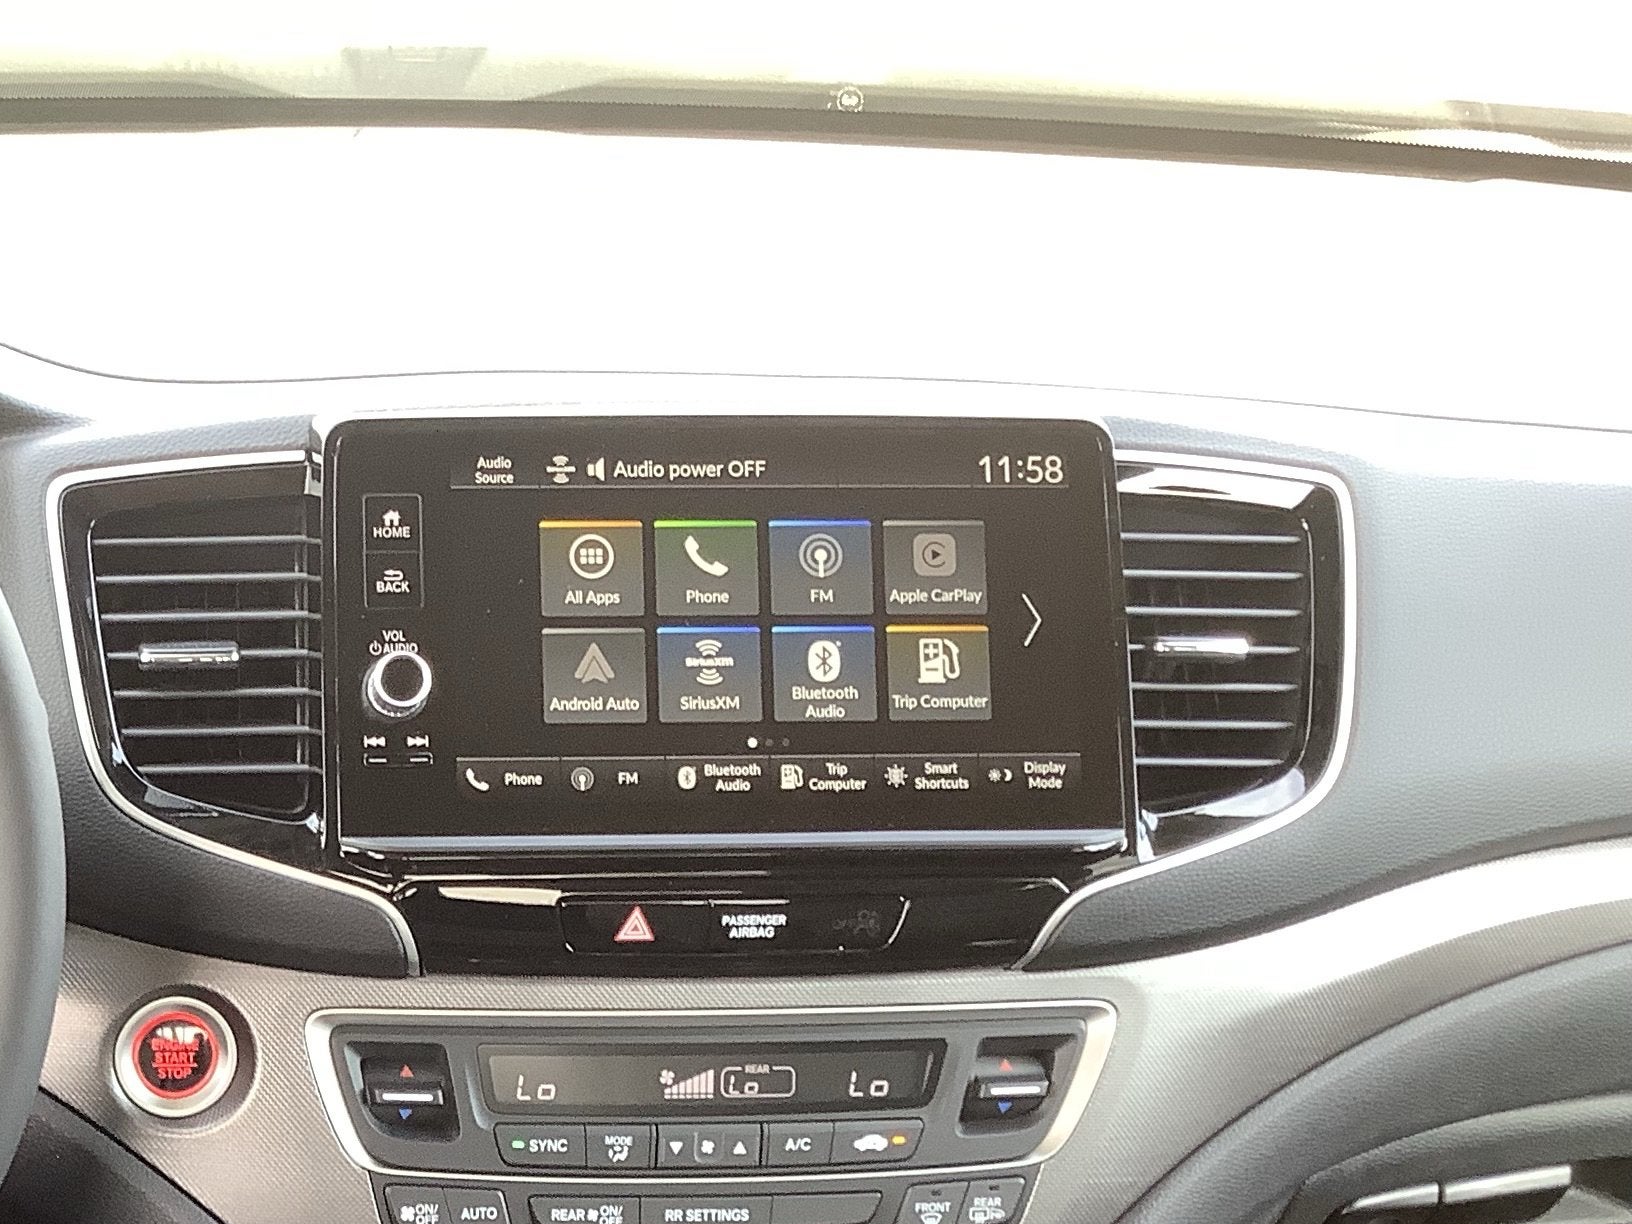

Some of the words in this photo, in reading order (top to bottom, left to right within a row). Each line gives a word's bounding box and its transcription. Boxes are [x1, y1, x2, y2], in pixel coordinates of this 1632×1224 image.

[476, 456, 512, 469] Audio
[978, 455, 1063, 484] 11:58
[613, 460, 665, 478] Audio
[669, 463, 723, 481] power
[728, 460, 766, 478] OFF
[475, 472, 514, 484] Source
[373, 526, 411, 538] HOME
[376, 581, 410, 593] BACK
[565, 590, 583, 604] All
[585, 590, 620, 607] Apps
[686, 589, 729, 604] Phone
[810, 588, 833, 603] FM
[889, 589, 928, 605] Apple
[931, 588, 982, 605] CarPlay
[382, 630, 406, 642] VOL
[383, 643, 418, 654] AUDIO
[792, 686, 859, 700] Bluetooth
[549, 696, 603, 711] Android
[606, 697, 640, 711] Auto
[680, 696, 740, 710] SiriusXM
[892, 694, 918, 710] Trip
[920, 695, 988, 710] Computer
[805, 704, 845, 718] Audio
[704, 763, 761, 777] Bluetooth
[825, 762, 848, 777] Trip
[924, 762, 958, 775] Smart
[1024, 761, 1066, 776] Display
[504, 772, 543, 786] Phone
[618, 772, 639, 785] FM
[715, 779, 751, 792] Audio
[808, 777, 867, 792] Computer
[915, 777, 969, 790] Shortcuts
[1028, 776, 1062, 790] Mode
[721, 914, 787, 927] PASSENGER
[729, 927, 775, 939] AIRBAG
[155, 1052, 196, 1064] START
[157, 1067, 192, 1080] STOP
[745, 1064, 770, 1074] REAR
[516, 1074, 556, 1101] Lo
[727, 1075, 759, 1096] Lo
[849, 1070, 889, 1099] Lo
[529, 1138, 568, 1153] SYNC
[605, 1135, 633, 1147] MODE
[785, 1137, 812, 1152] A/C
[915, 1202, 951, 1214] FRONT
[974, 1197, 1002, 1207] REAR
[415, 1204, 439, 1215] ON/
[461, 1207, 498, 1221] AUTO
[551, 1208, 585, 1222] REAR
[600, 1205, 623, 1216] ON/
[665, 1208, 684, 1222] RR
[686, 1208, 750, 1222] SETTINGS
